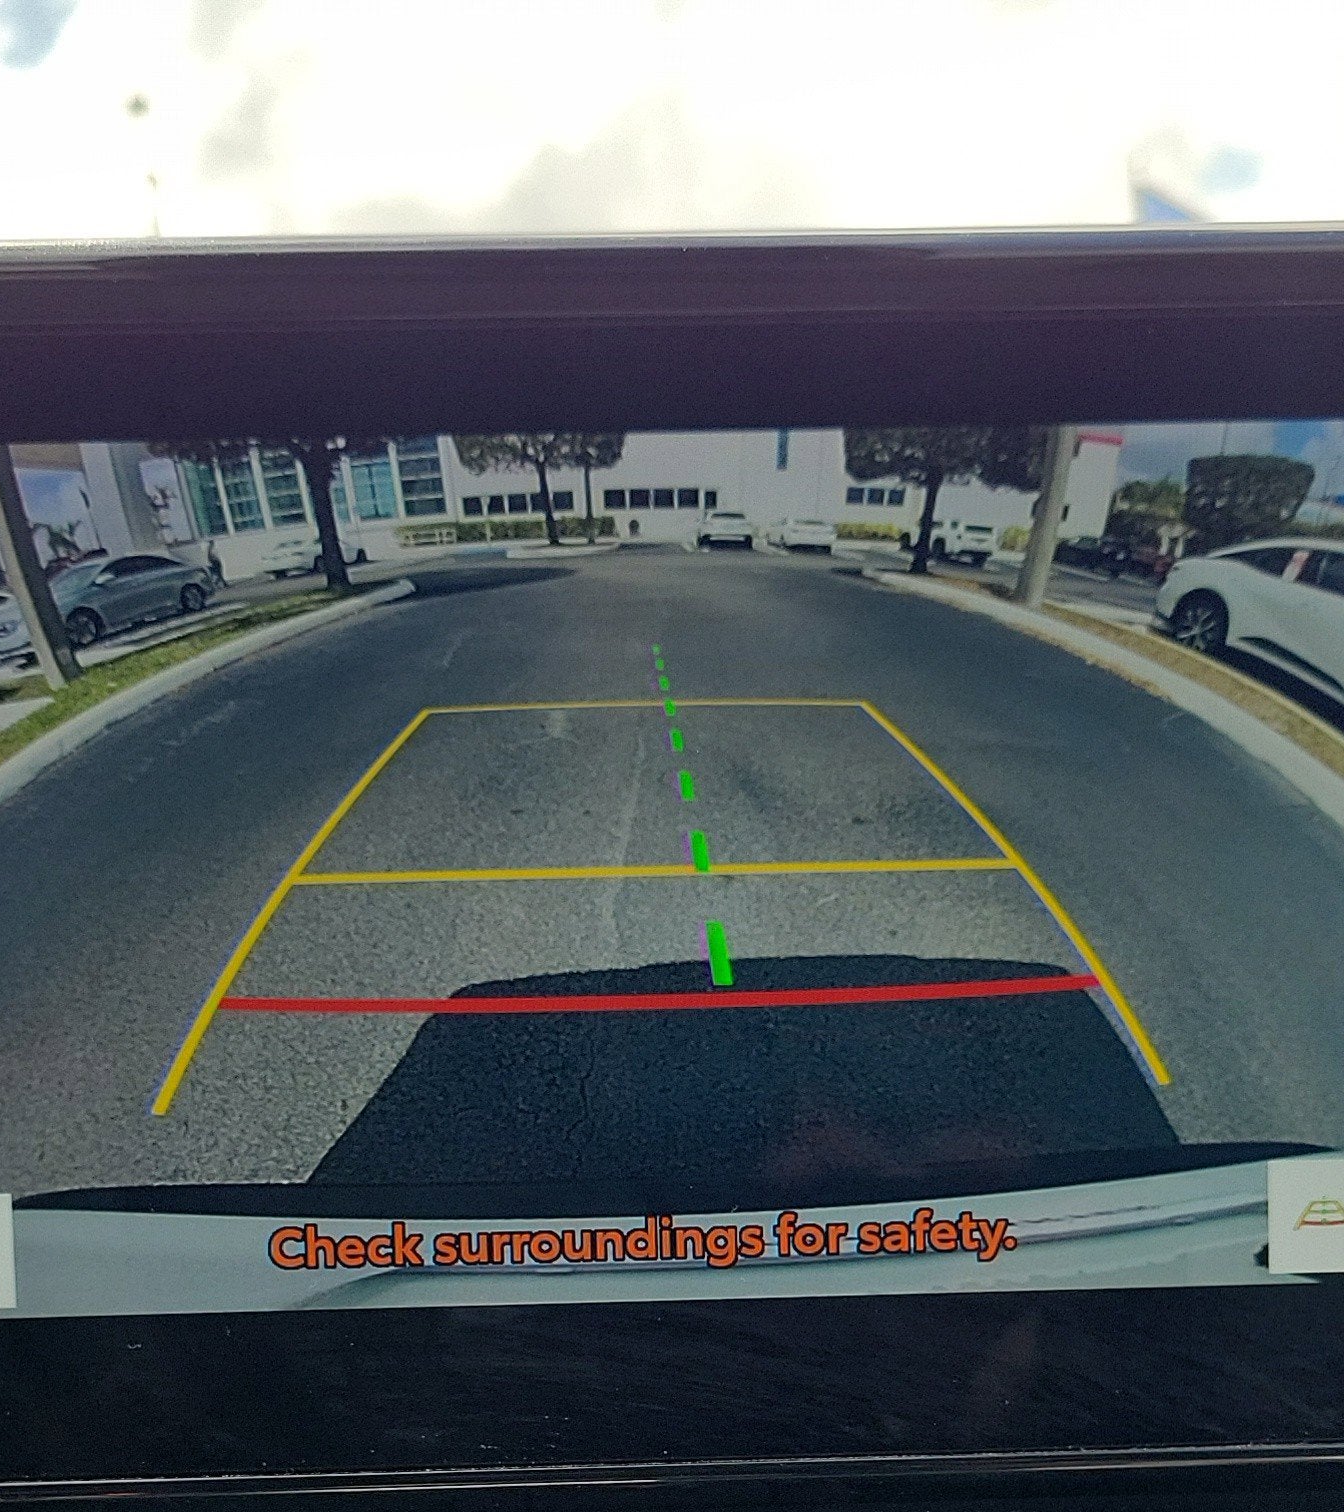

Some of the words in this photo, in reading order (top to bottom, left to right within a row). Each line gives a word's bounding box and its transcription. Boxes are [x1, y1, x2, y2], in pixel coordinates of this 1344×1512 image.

[268, 1220, 425, 1271] Check
[433, 1213, 765, 1269] surroundings
[773, 1210, 849, 1258] for
[857, 1206, 1018, 1263] safety.
